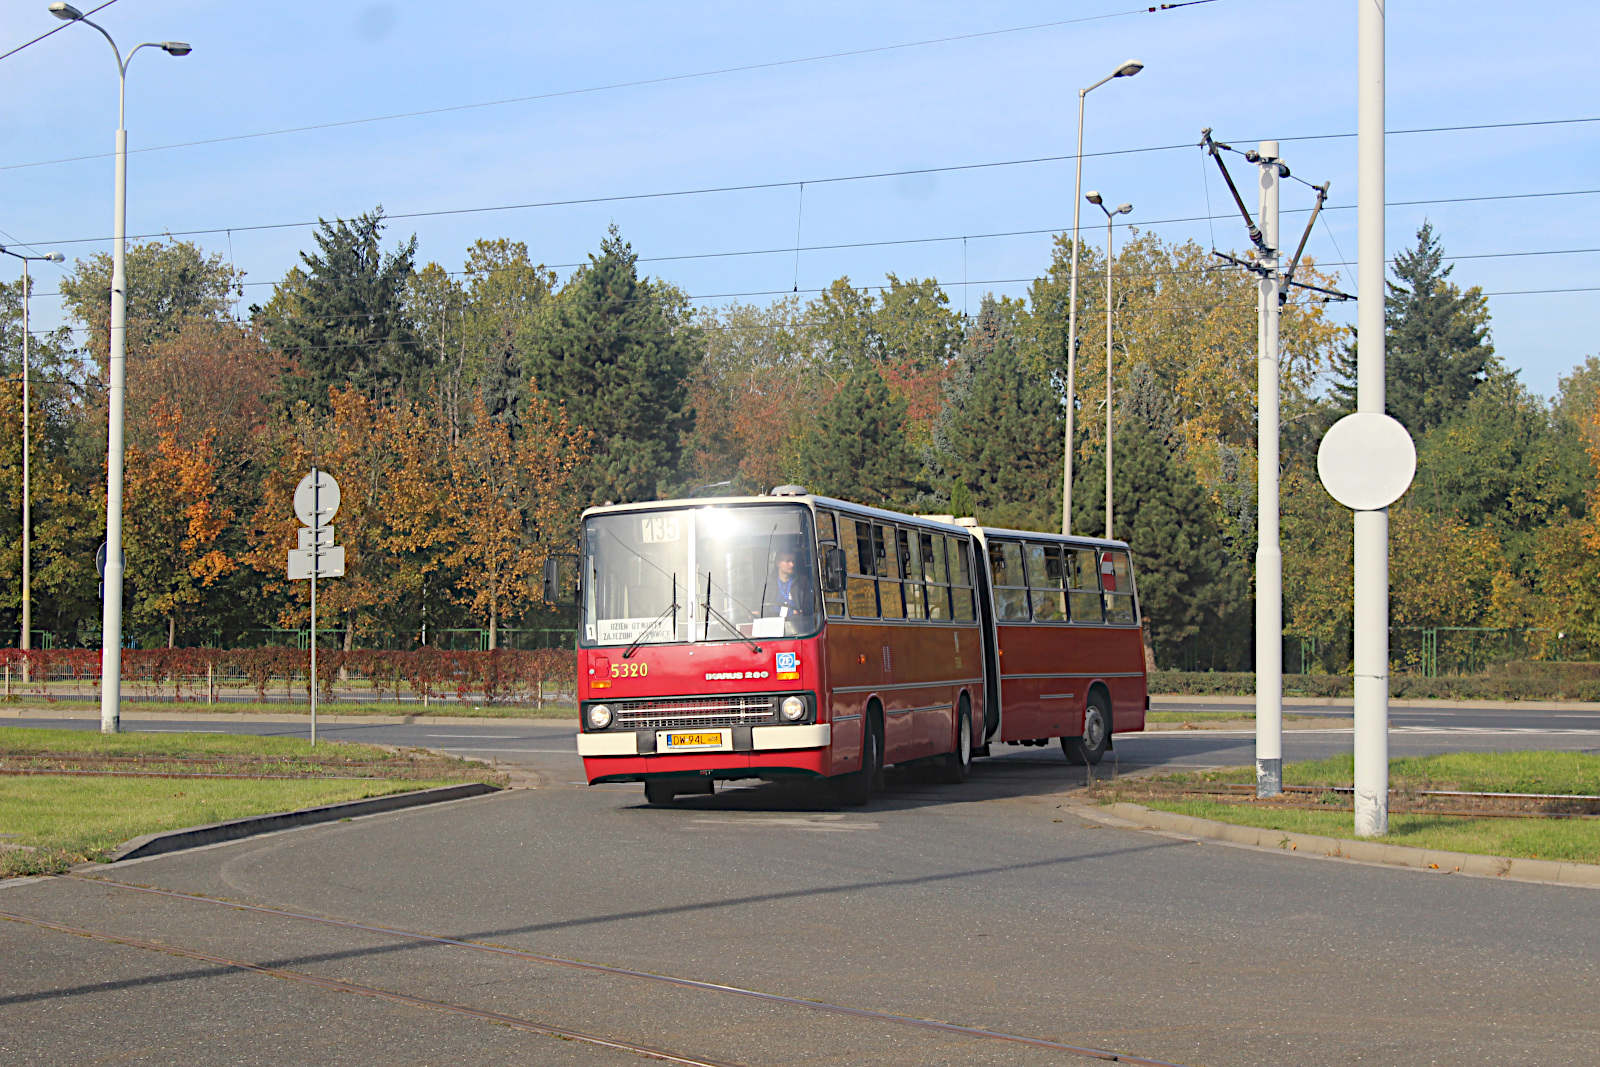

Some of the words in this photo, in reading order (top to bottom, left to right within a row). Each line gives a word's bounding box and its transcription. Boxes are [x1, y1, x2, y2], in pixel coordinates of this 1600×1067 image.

[645, 518, 677, 541] 135
[611, 662, 649, 678] 5320
[705, 671, 744, 681] IKARUS
[673, 735, 686, 745] DW
[688, 734, 707, 745] 94L
